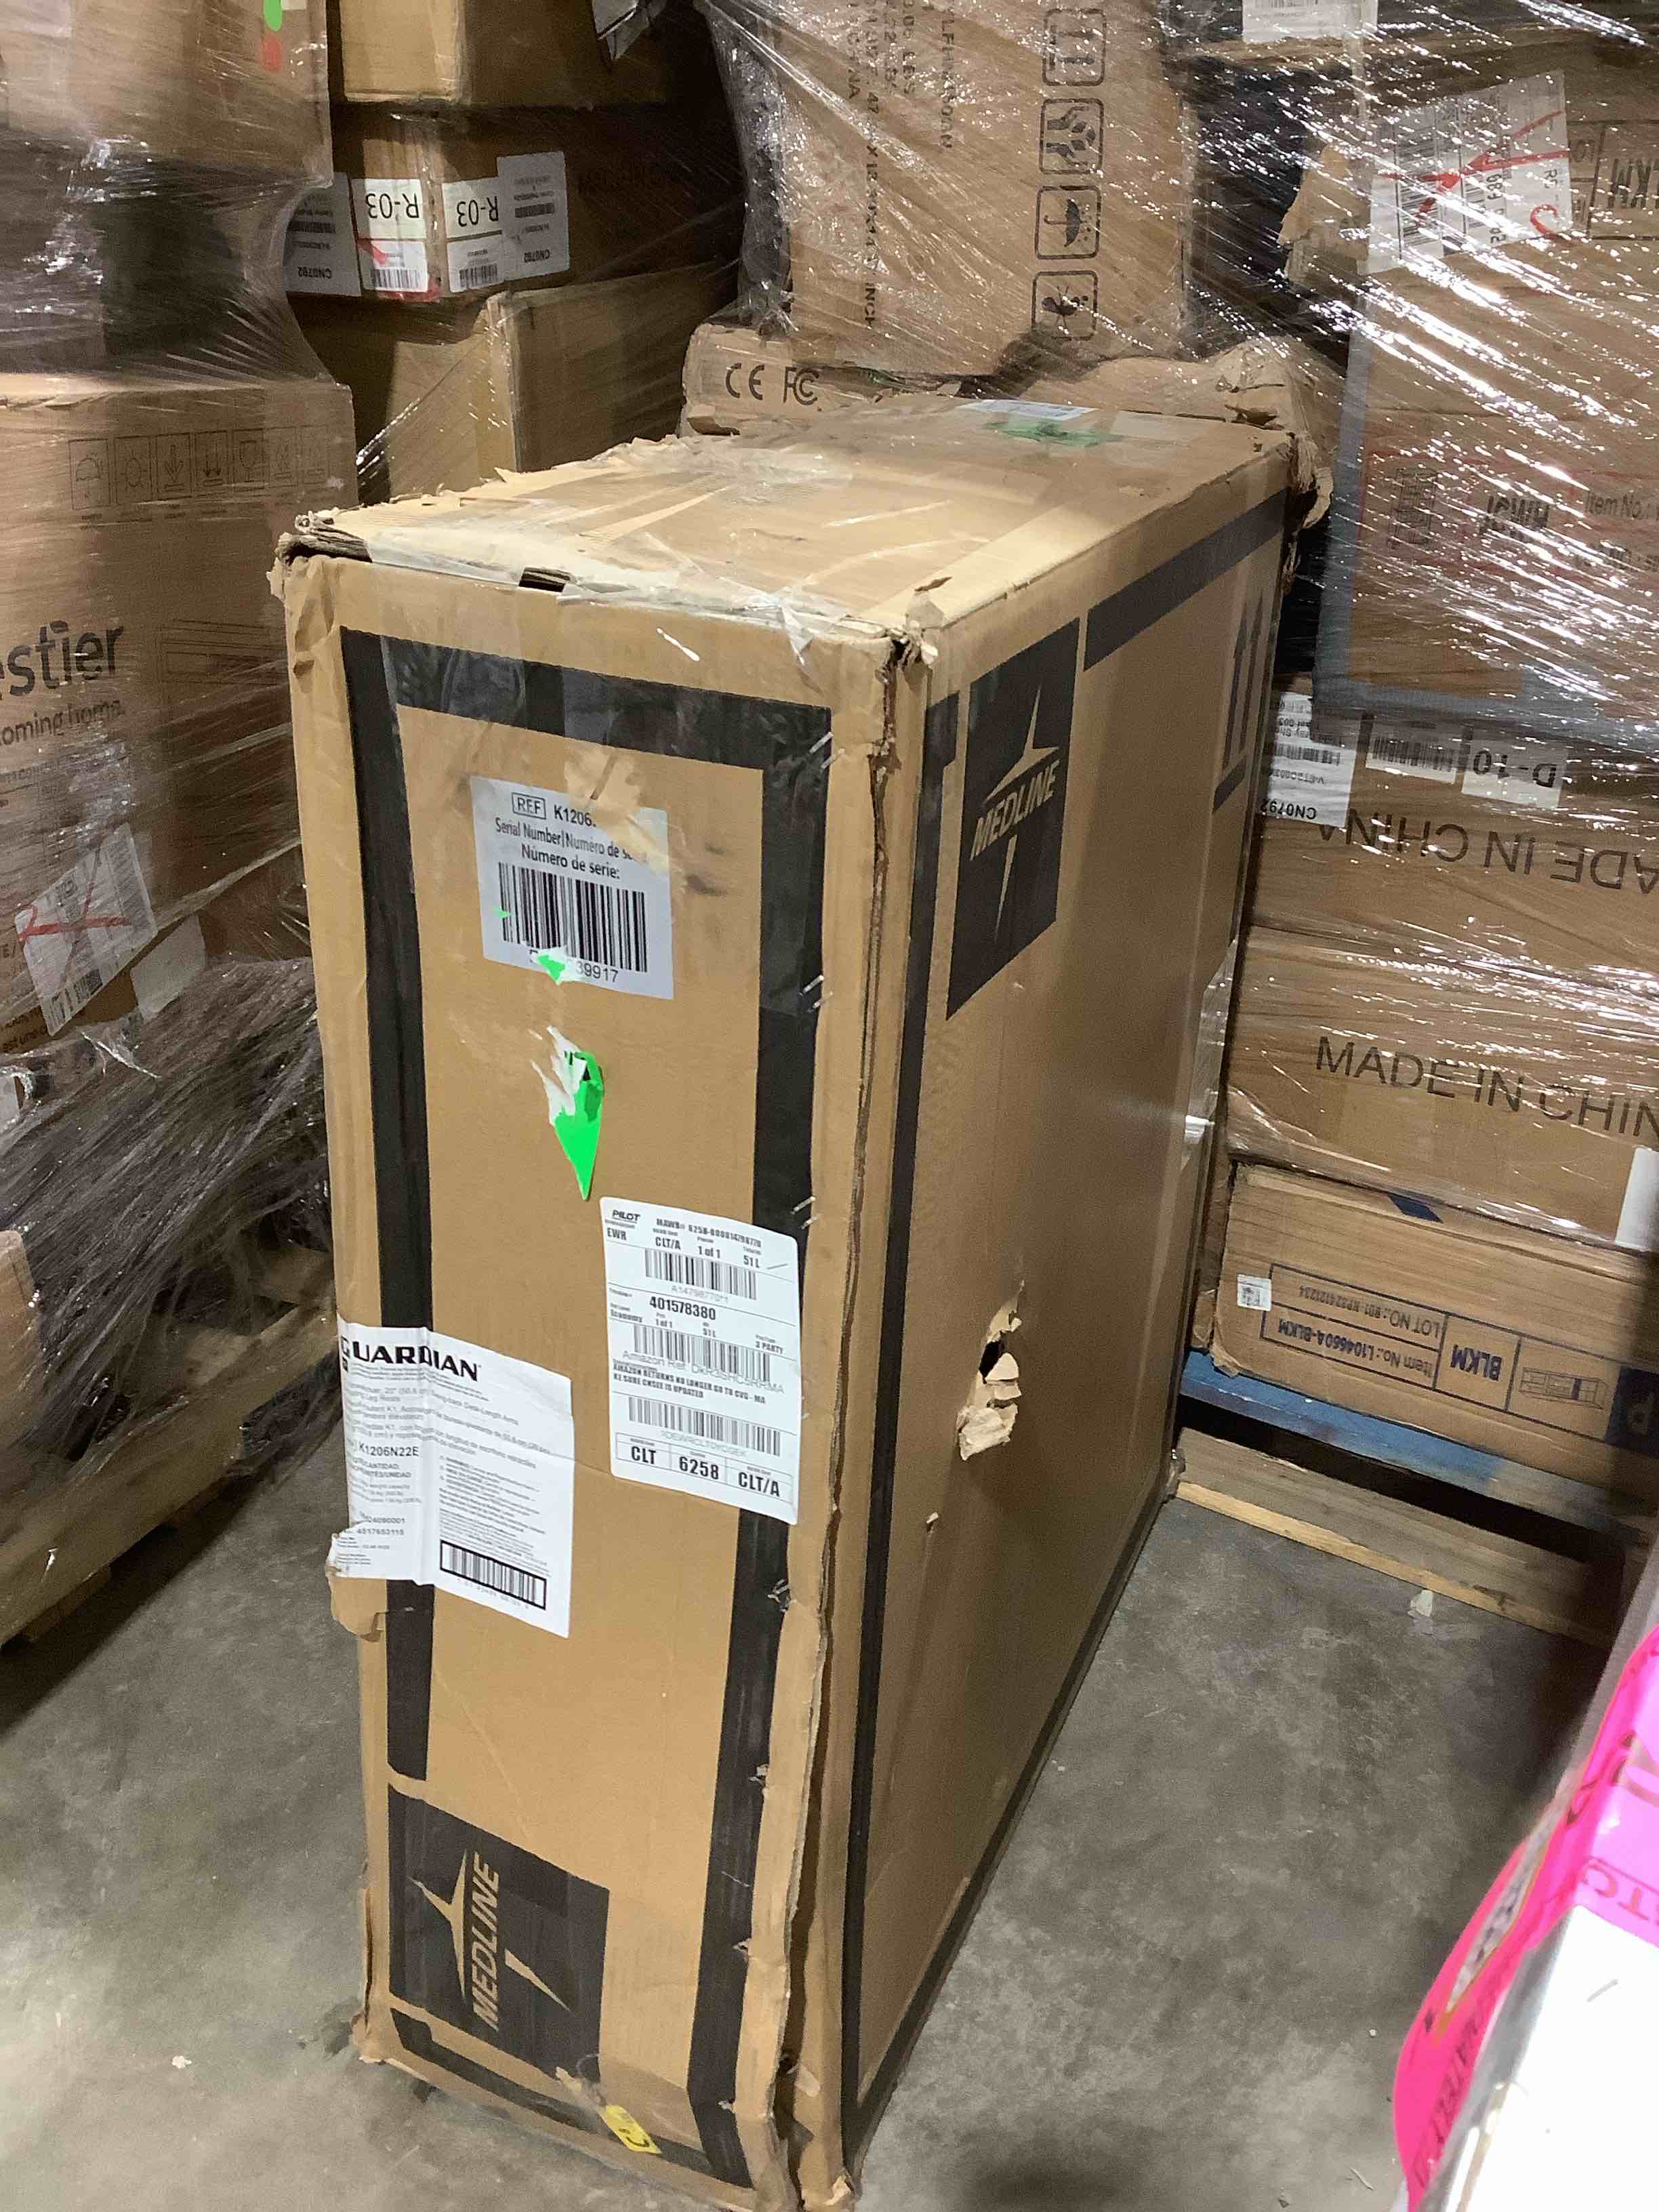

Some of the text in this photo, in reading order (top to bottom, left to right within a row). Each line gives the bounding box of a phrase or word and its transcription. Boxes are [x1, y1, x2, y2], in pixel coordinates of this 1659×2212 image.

[365, 192, 419, 219] R-03
[455, 195, 499, 228] R-03
[725, 363, 765, 401] CE
[0, 620, 123, 701] stier
[0, 712, 64, 746] oming
[1472, 750, 1557, 788] D-10
[517, 796, 596, 827] REF K1206
[969, 760, 1061, 862] MEDLINE
[1260, 798, 1317, 821] CN0792
[495, 817, 520, 836] Serial
[607, 844, 619, 857] de
[1484, 831, 1534, 874] IN
[571, 854, 586, 872] de
[1551, 841, 1659, 895] ADE
[1316, 1036, 1659, 1139] MADE IN CHIN
[612, 1210, 640, 1222] PILOT
[607, 1227, 627, 1241] EWR
[655, 1237, 681, 1251] CLT/A
[649, 1295, 716, 1321] 401578380
[1413, 1317, 1440, 1338] LOT
[1404, 1355, 1431, 1377] Item
[1451, 1344, 1502, 1382] BLKM
[358, 1441, 419, 1458] K1206N22E
[631, 1446, 780, 1498] CLT 6258 CLT/A
[471, 1851, 500, 2032] MEDLINE
